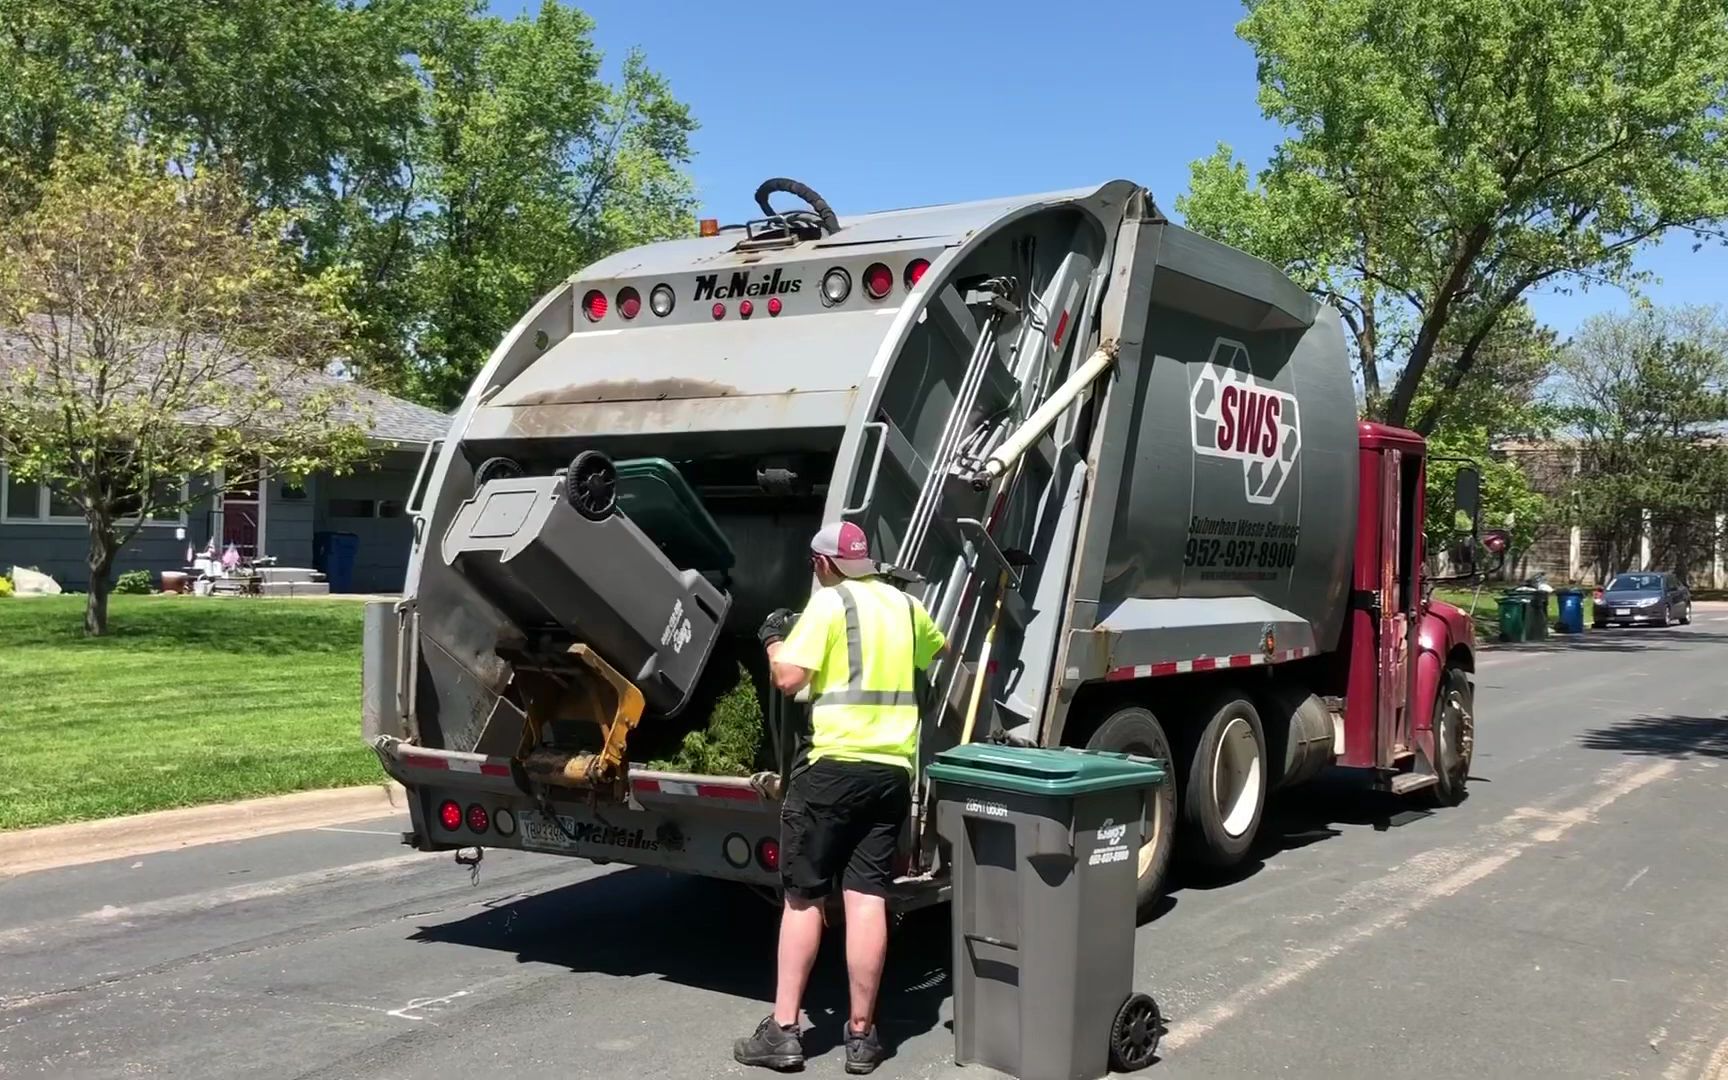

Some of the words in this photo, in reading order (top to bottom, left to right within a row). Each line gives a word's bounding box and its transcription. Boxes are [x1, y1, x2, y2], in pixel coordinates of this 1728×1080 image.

[693, 268, 802, 301] McNeilus
[1217, 385, 1280, 458] SWS
[1188, 515, 1237, 536] Suburban
[1237, 518, 1265, 537] Waste
[1265, 520, 1299, 539] Services
[1184, 538, 1297, 568] 952-937-8900
